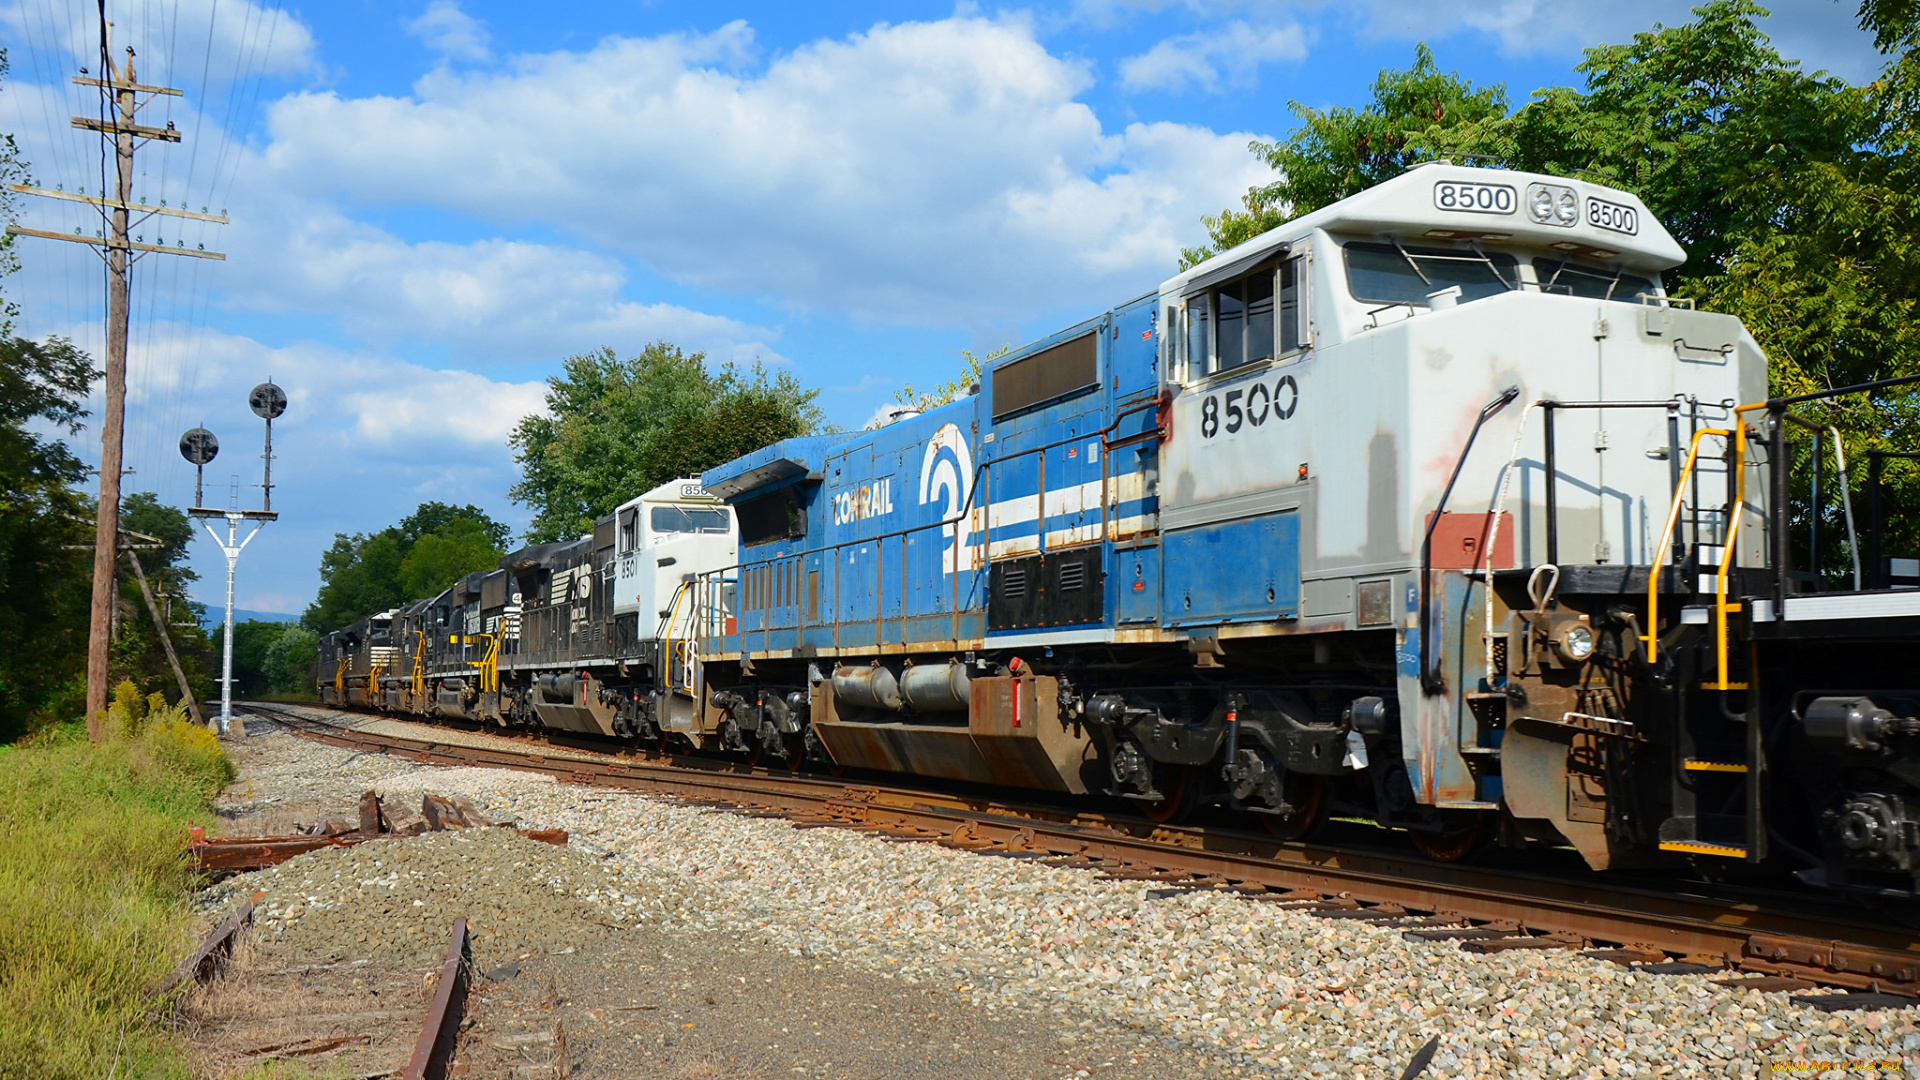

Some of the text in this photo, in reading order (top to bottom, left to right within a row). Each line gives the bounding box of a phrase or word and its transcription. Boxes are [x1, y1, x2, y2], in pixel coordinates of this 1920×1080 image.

[1440, 184, 1511, 212] 8500
[1590, 202, 1634, 231] 8500
[1202, 375, 1298, 438] 8500
[834, 479, 893, 526] CONRAIL
[622, 558, 637, 579] 8501
[1408, 588, 1416, 602] F
